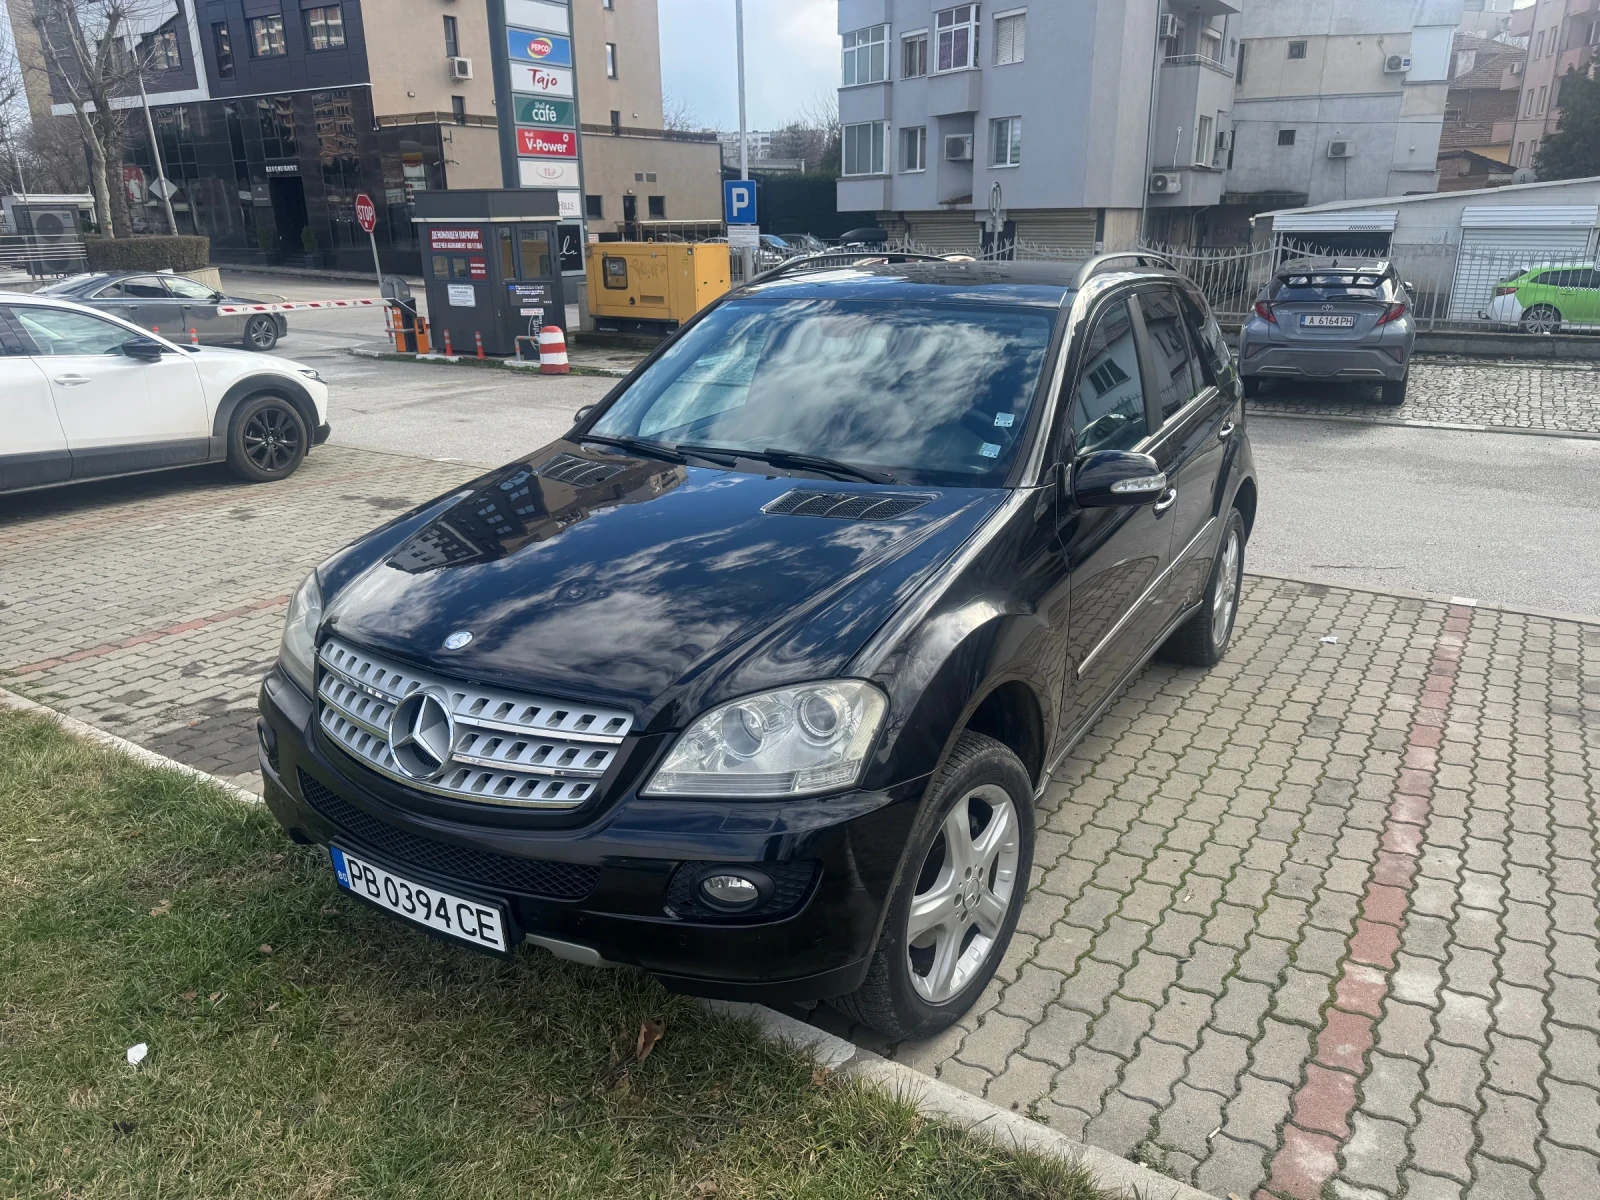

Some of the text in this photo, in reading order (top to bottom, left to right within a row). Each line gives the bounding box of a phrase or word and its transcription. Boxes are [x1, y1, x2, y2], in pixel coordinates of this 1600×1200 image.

[531, 43, 549, 52] PEPCO
[527, 68, 558, 90] Tajo
[532, 105, 557, 122] café
[526, 138, 567, 152] V-Power
[732, 188, 749, 216] P
[356, 206, 374, 222] STOP
[1308, 315, 1352, 326] A 6164 PH
[347, 858, 499, 945] PB 0394 CE
